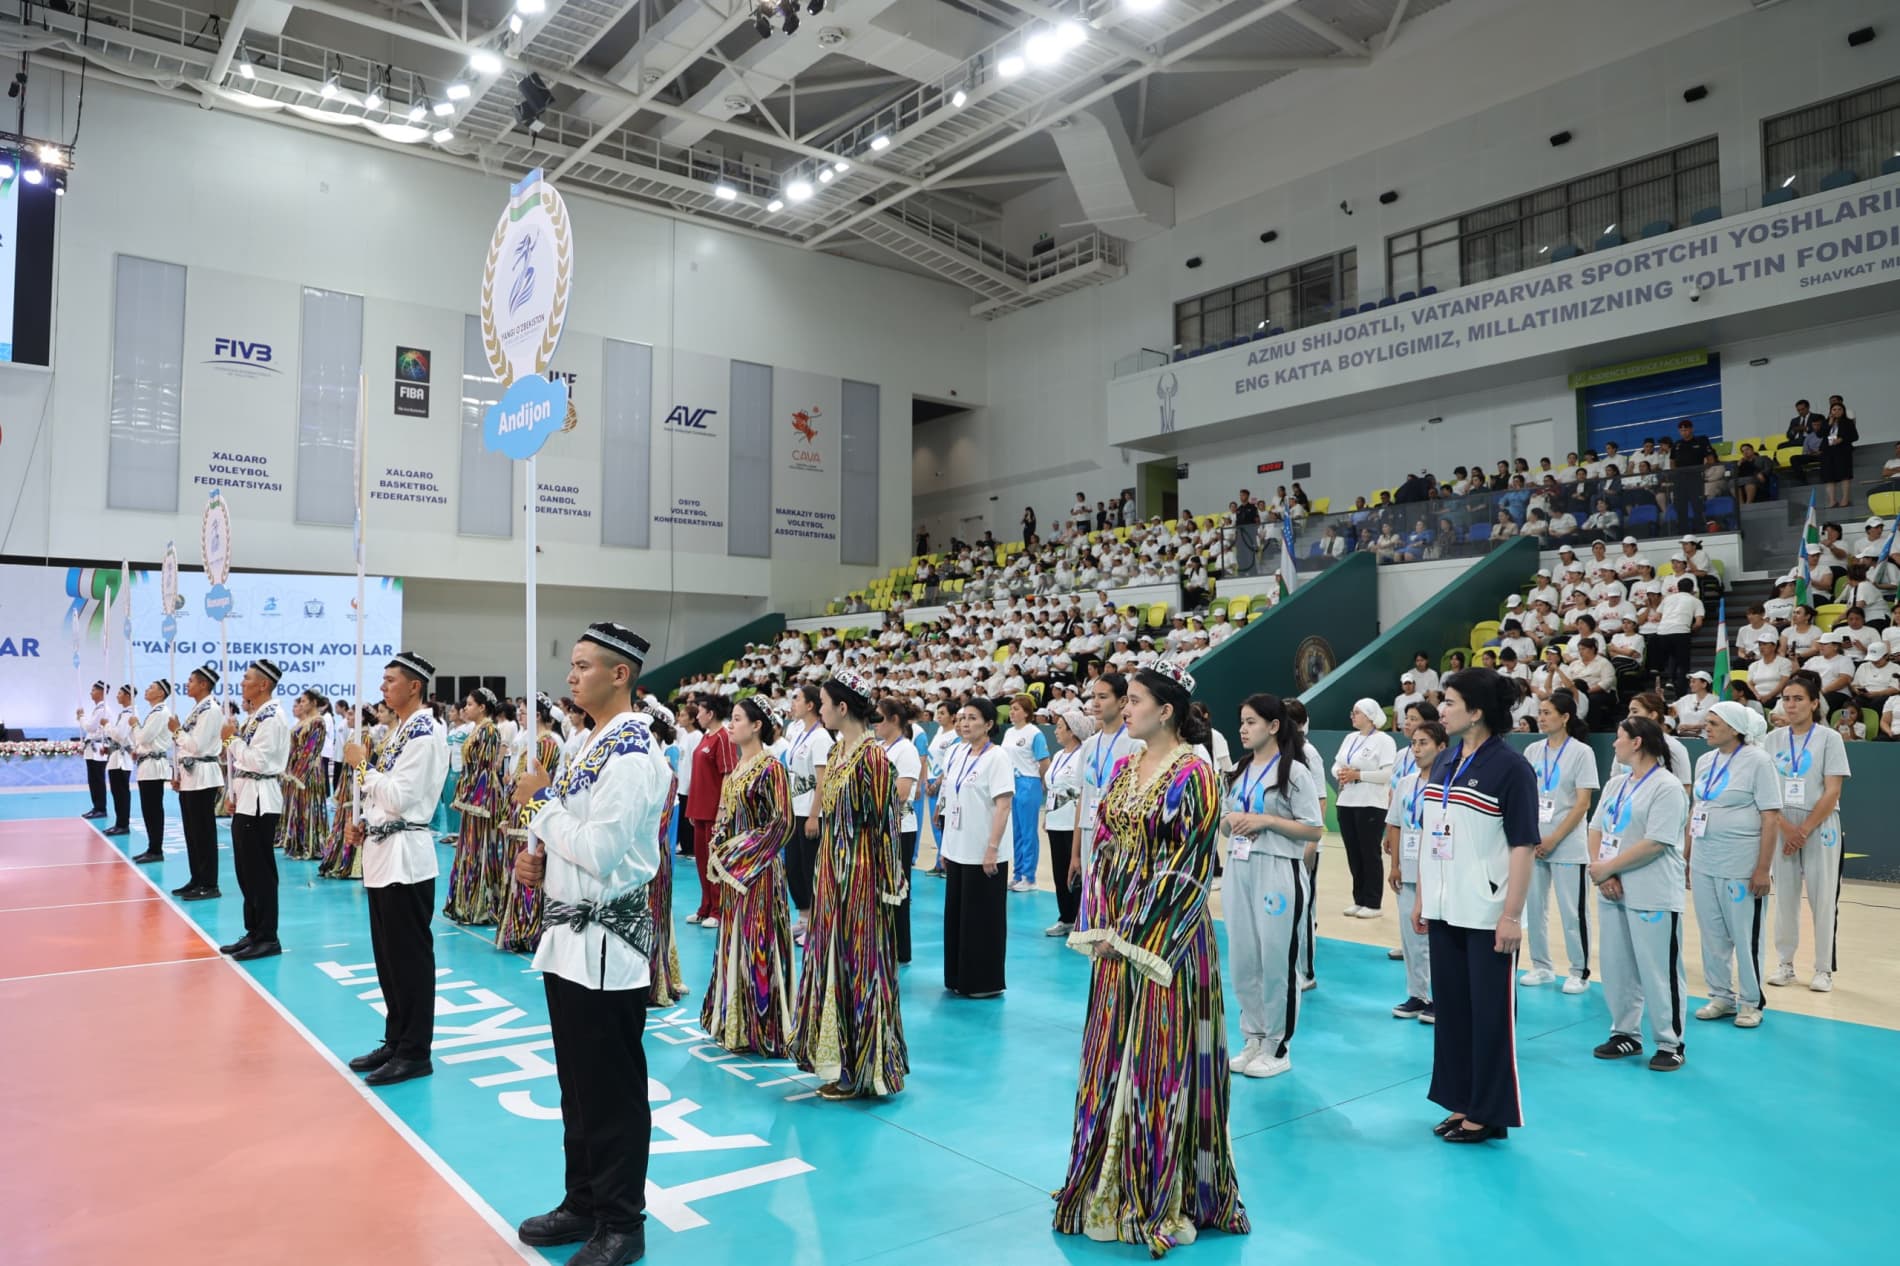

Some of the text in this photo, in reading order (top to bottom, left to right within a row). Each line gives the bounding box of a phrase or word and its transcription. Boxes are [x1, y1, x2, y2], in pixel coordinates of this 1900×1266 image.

[1800, 261, 1876, 288] SHAVKAT
[1247, 341, 1296, 366] AZMU
[1302, 315, 1405, 353] SHIJOATLI,
[1411, 273, 1573, 326] VATANPARVAR
[1581, 235, 1718, 286] SPORTCHI
[1235, 374, 1270, 395] ENG
[1275, 359, 1333, 385] KATTA
[1338, 330, 1461, 371] BOYLIGIMIZ,
[1468, 280, 1673, 342] MILLATIMIZNING
[1682, 254, 1786, 291] "OLTIN
[215, 337, 272, 362] FIVB
[400, 386, 424, 400] FIBA
[498, 400, 551, 435] Andijon
[665, 405, 717, 429] AVC
[213, 451, 267, 465] XALQARO
[792, 449, 821, 463] CAVA
[209, 464, 269, 477] VOLEYBOL
[386, 468, 434, 480] XALQARO
[194, 476, 282, 492] FEDERATSIYASI
[380, 480, 439, 492] BASKETBOL
[537, 484, 579, 494] XALQARO
[370, 491, 447, 504] FEDERATSIYASI
[539, 495, 576, 505] GANBOL
[678, 499, 701, 507] OSIYO
[524, 504, 592, 517] DERATSIYASI
[671, 508, 708, 517] VOLEYBOL
[775, 508, 836, 521] MARKAZIY OSIYO
[654, 516, 724, 528] KONFEDERATSIYASI
[787, 519, 824, 529] VOLEYBOL
[774, 528, 836, 540] ASSOTSIATSIYASI
[320, 643, 393, 656] AYOLLAR
